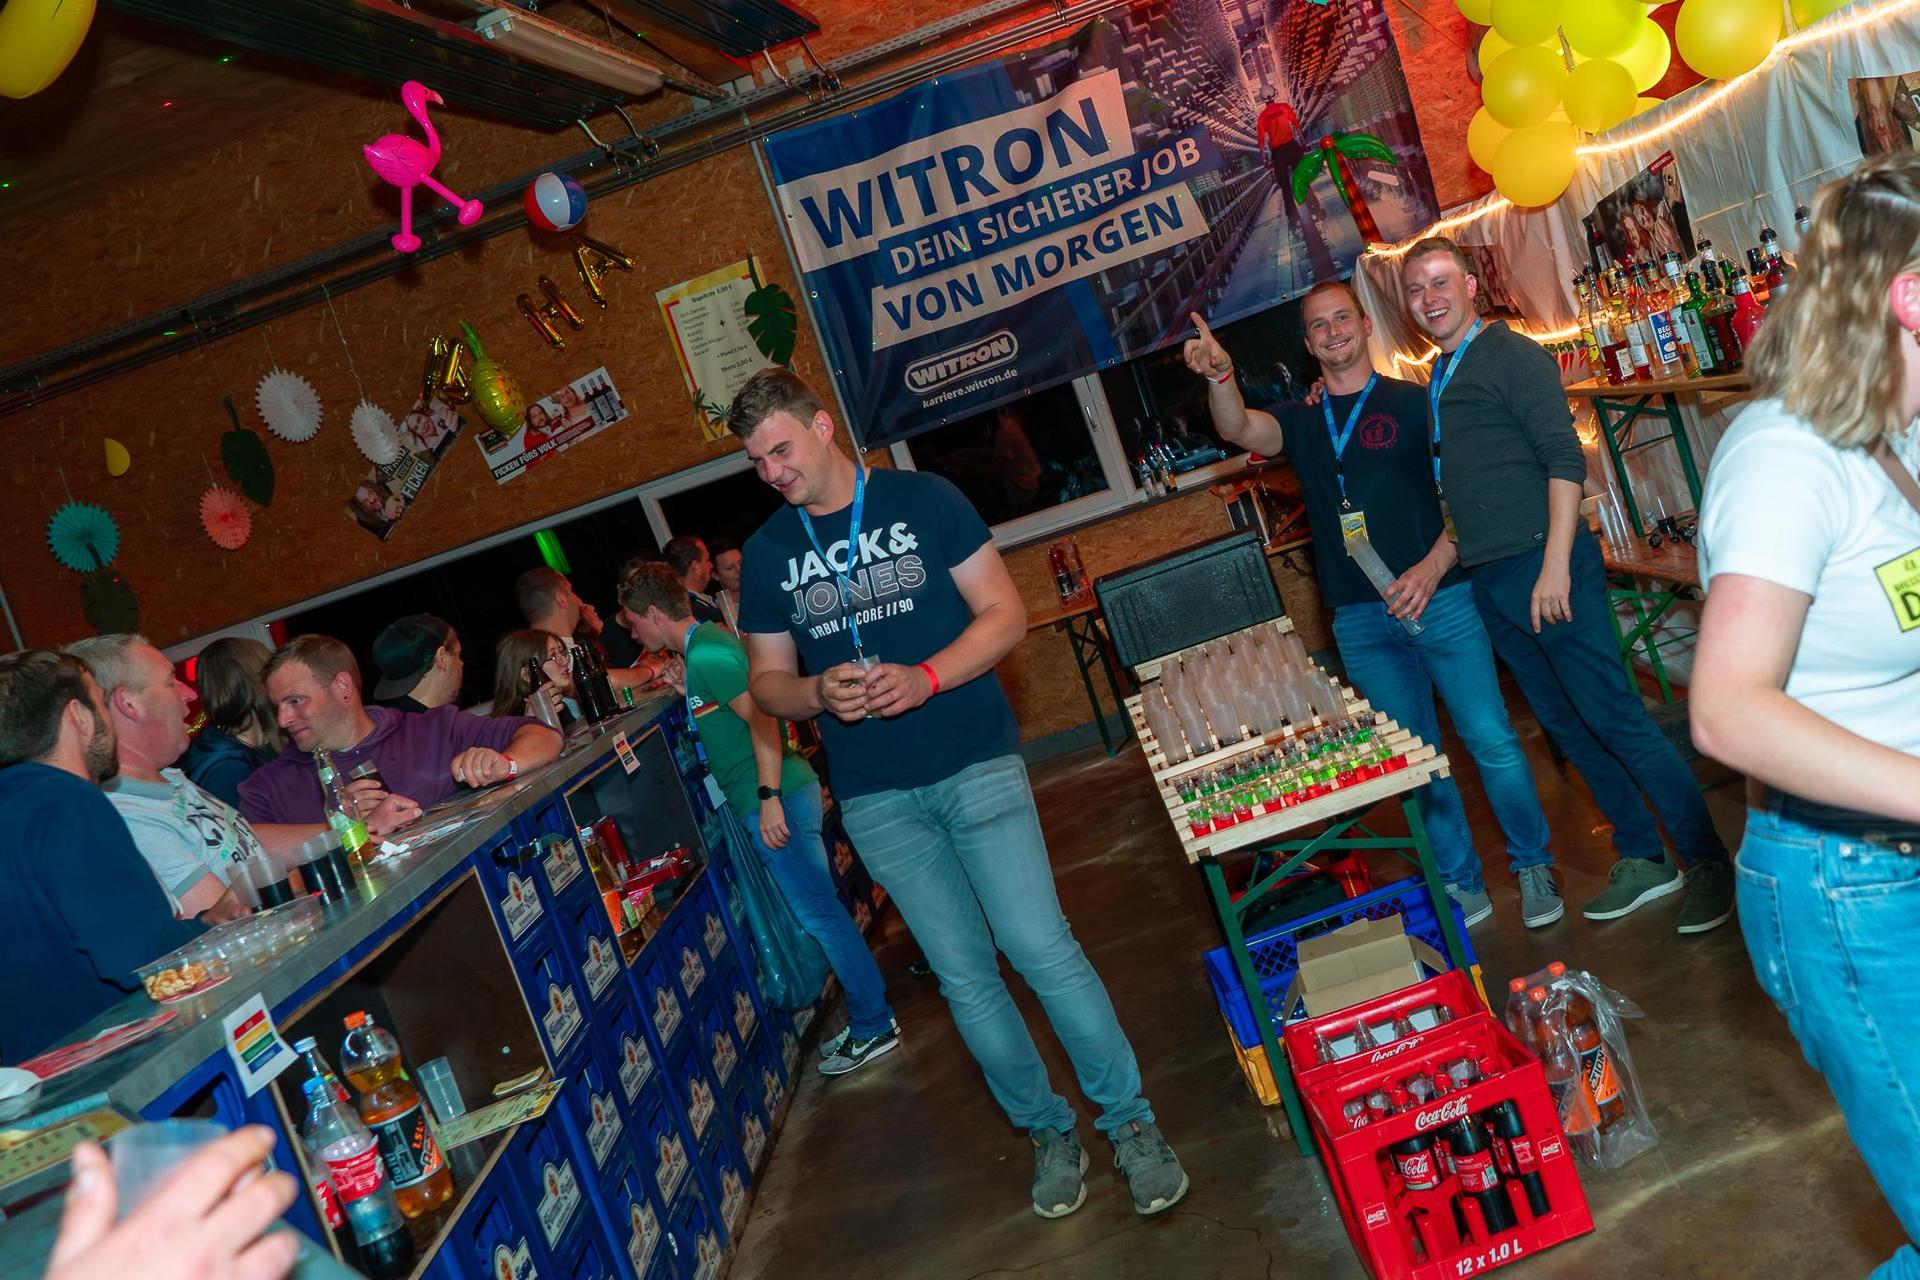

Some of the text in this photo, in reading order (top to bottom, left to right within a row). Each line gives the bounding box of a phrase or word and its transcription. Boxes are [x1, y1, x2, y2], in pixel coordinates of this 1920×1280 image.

[799, 96, 1110, 249] WITRON
[890, 137, 1201, 275] DEIN SICHERER JOB
[882, 195, 1185, 332] VON MORGEN
[909, 336, 1012, 387] WITRON
[921, 367, 1019, 409] karriere.witron.de
[494, 438, 559, 479] FICKEN FÜRS VOLK
[400, 460, 430, 500] FICKEN
[790, 554, 927, 625] JONES
[808, 619, 840, 640] URBN
[855, 605, 885, 626] CORE
[1414, 1095, 1470, 1131] Coca-Cola
[1455, 1239, 1524, 1277] 12 x 1.0 L
